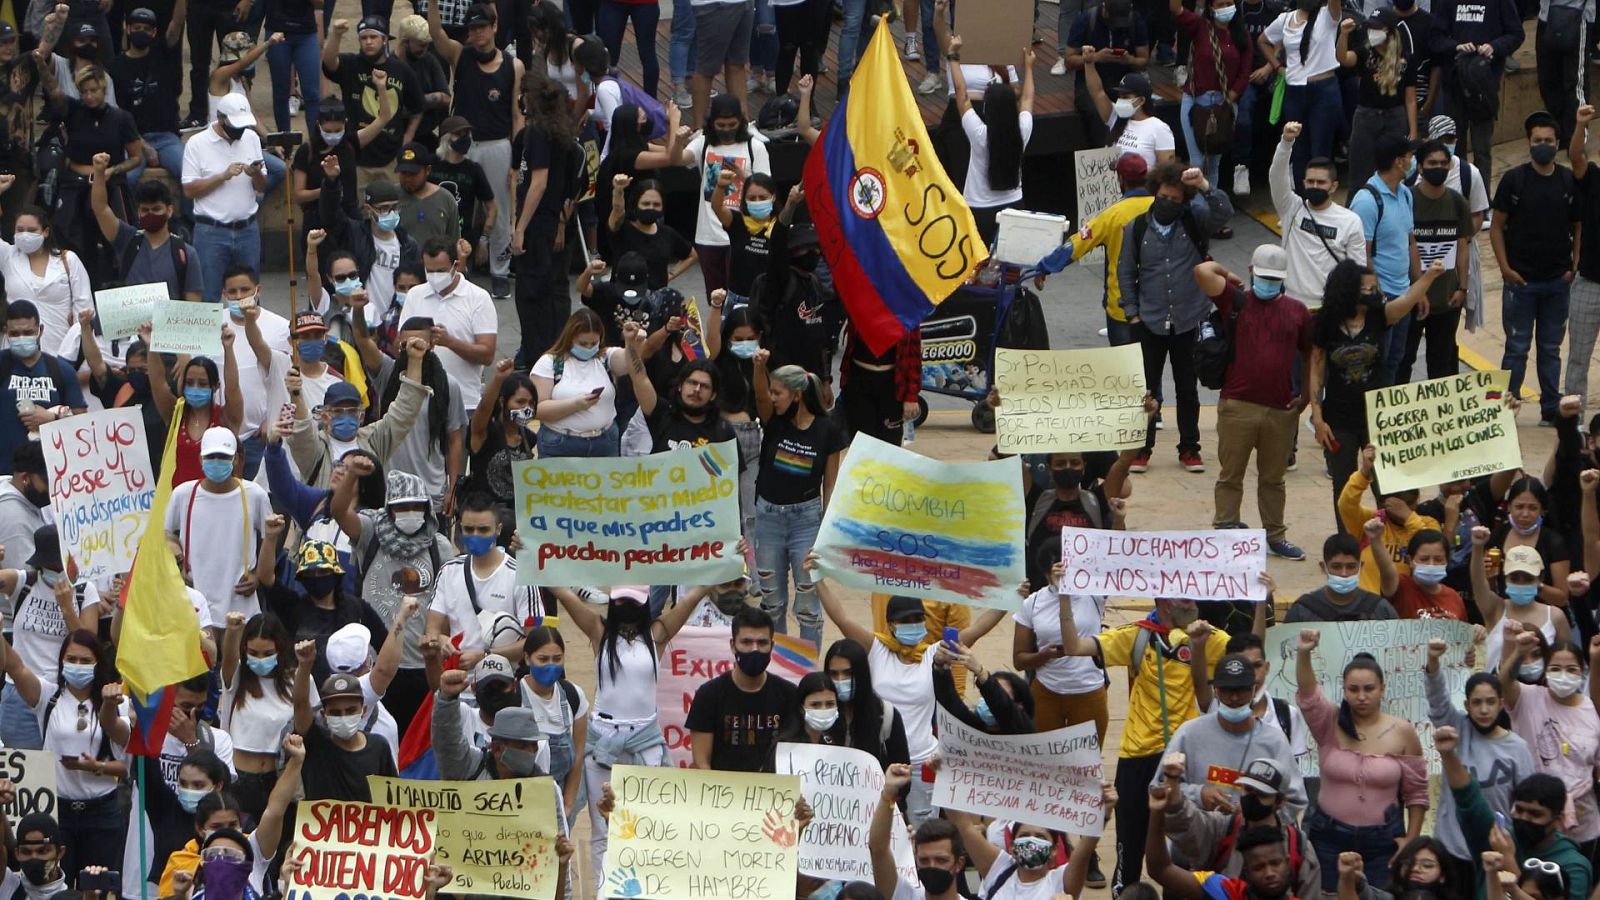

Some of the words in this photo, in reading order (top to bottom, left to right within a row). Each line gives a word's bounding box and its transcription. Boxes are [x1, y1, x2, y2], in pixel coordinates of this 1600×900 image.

[904, 182, 974, 280] SOS
[17, 389, 51, 402] DIVISION
[1025, 376, 1097, 395] ESMAD
[1103, 373, 1144, 392] QUE
[1375, 390, 1386, 409] A
[1389, 387, 1410, 407] LOS
[1416, 379, 1450, 402] AMOS
[1455, 374, 1473, 393] DE
[1477, 372, 1493, 388] LA
[1001, 396, 1053, 413] DIOS
[1057, 393, 1087, 410] LOS
[1092, 391, 1146, 407] PERDON
[1376, 408, 1429, 431] GUERRA
[1437, 404, 1454, 419] NO
[1460, 395, 1480, 412] LES
[997, 417, 1030, 432] POR
[1035, 415, 1114, 430] ATENTAR
[1377, 422, 1428, 447] IMPORTA
[1432, 418, 1455, 436] QUE
[1458, 404, 1502, 429] MUERAN
[75, 420, 99, 457] si
[105, 420, 136, 470] yo
[999, 432, 1058, 448] CONTRA
[1070, 432, 1092, 445] DE
[1096, 432, 1113, 445] TU
[1381, 450, 1396, 469] NI
[1400, 443, 1428, 463] ELLOS
[1431, 441, 1445, 457] NI
[1446, 436, 1465, 451] LOS
[1467, 423, 1505, 446] CIVILES
[51, 466, 111, 512] fuese
[522, 465, 602, 491] Quiero
[608, 463, 661, 491] salir
[668, 466, 687, 484] a
[525, 491, 635, 516] protestar
[640, 491, 668, 513] sin
[860, 476, 966, 521] COLOMBIA
[530, 514, 548, 532] a
[555, 516, 598, 539] que
[638, 511, 716, 545] padres
[79, 519, 116, 566] igual
[537, 540, 621, 571] puedan
[876, 530, 940, 559] SOS
[1073, 534, 1088, 555] O
[1107, 536, 1220, 560] LUCHAMOS
[1231, 537, 1261, 560] SOS
[851, 553, 880, 569] Area
[883, 558, 898, 571] de
[923, 565, 961, 580] salud
[875, 571, 932, 591] Presente
[1073, 568, 1091, 590] O
[1103, 568, 1149, 592] NOS
[1159, 569, 1249, 598] MATAN
[26, 607, 44, 617] LOS
[46, 611, 63, 620] MIE
[29, 596, 61, 612] PIER
[22, 622, 36, 632] LA
[40, 625, 67, 638] MAG
[34, 616, 66, 629] EMPIE
[1337, 620, 1390, 648] VAS
[1393, 620, 1408, 645] A
[1409, 619, 1472, 642] PASAR
[481, 659, 504, 672] ARG
[940, 712, 953, 735] NI
[1020, 743, 1045, 757] NI
[474, 783, 524, 813] SEA!
[622, 775, 688, 806] DICEN
[700, 783, 735, 809] MIS
[743, 785, 795, 818] HIJOS
[949, 786, 957, 804] Y
[966, 786, 1020, 809] ASESINA
[1024, 798, 1040, 812] AL
[951, 768, 1025, 792] DEFIENDE
[1029, 781, 1045, 797] AL
[1048, 784, 1065, 801] DE
[1068, 788, 1105, 811] ARRIBA
[302, 801, 436, 855] SABEMOS
[462, 828, 487, 848] que
[496, 826, 544, 845] dispara
[635, 815, 679, 842] QUE
[689, 820, 721, 842] NO
[731, 821, 763, 843] SE
[462, 847, 525, 867] ARMAS
[618, 846, 702, 869] QUIEREN
[723, 849, 786, 871] MORIR
[294, 846, 376, 891] QUIEN
[382, 853, 430, 899] DIO
[492, 871, 532, 892] Pueblo
[645, 872, 673, 896] DE
[688, 874, 772, 899] HAMBRE
